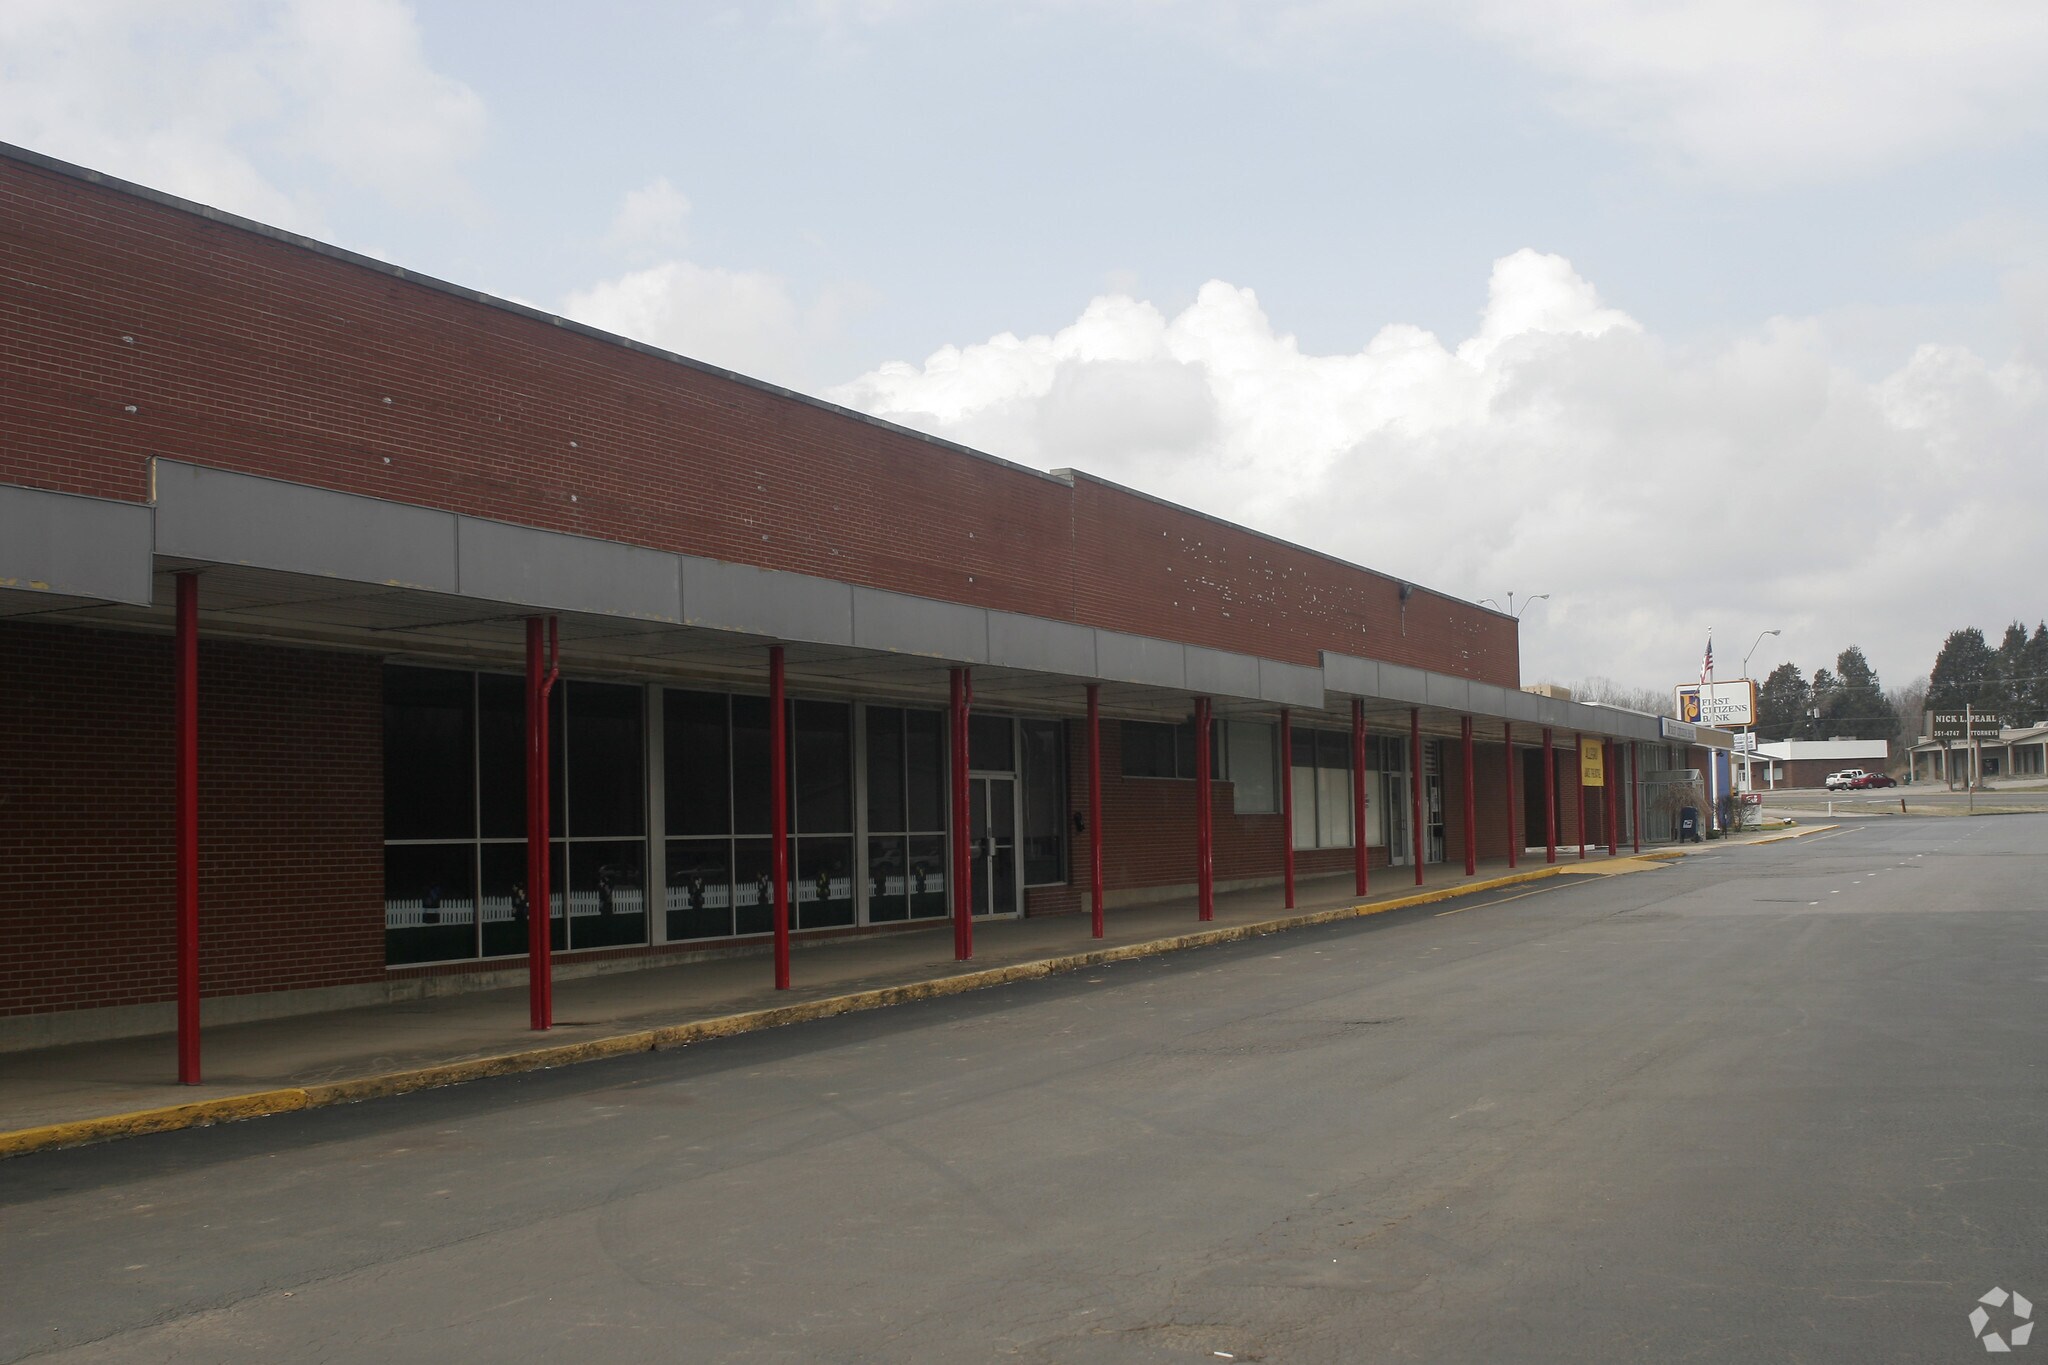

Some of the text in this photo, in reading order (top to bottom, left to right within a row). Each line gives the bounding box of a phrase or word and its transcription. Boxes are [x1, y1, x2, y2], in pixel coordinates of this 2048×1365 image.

[1702, 697, 1729, 705] FIRST
[1702, 705, 1747, 714] CITIZENS
[1703, 714, 1729, 722] BNK
